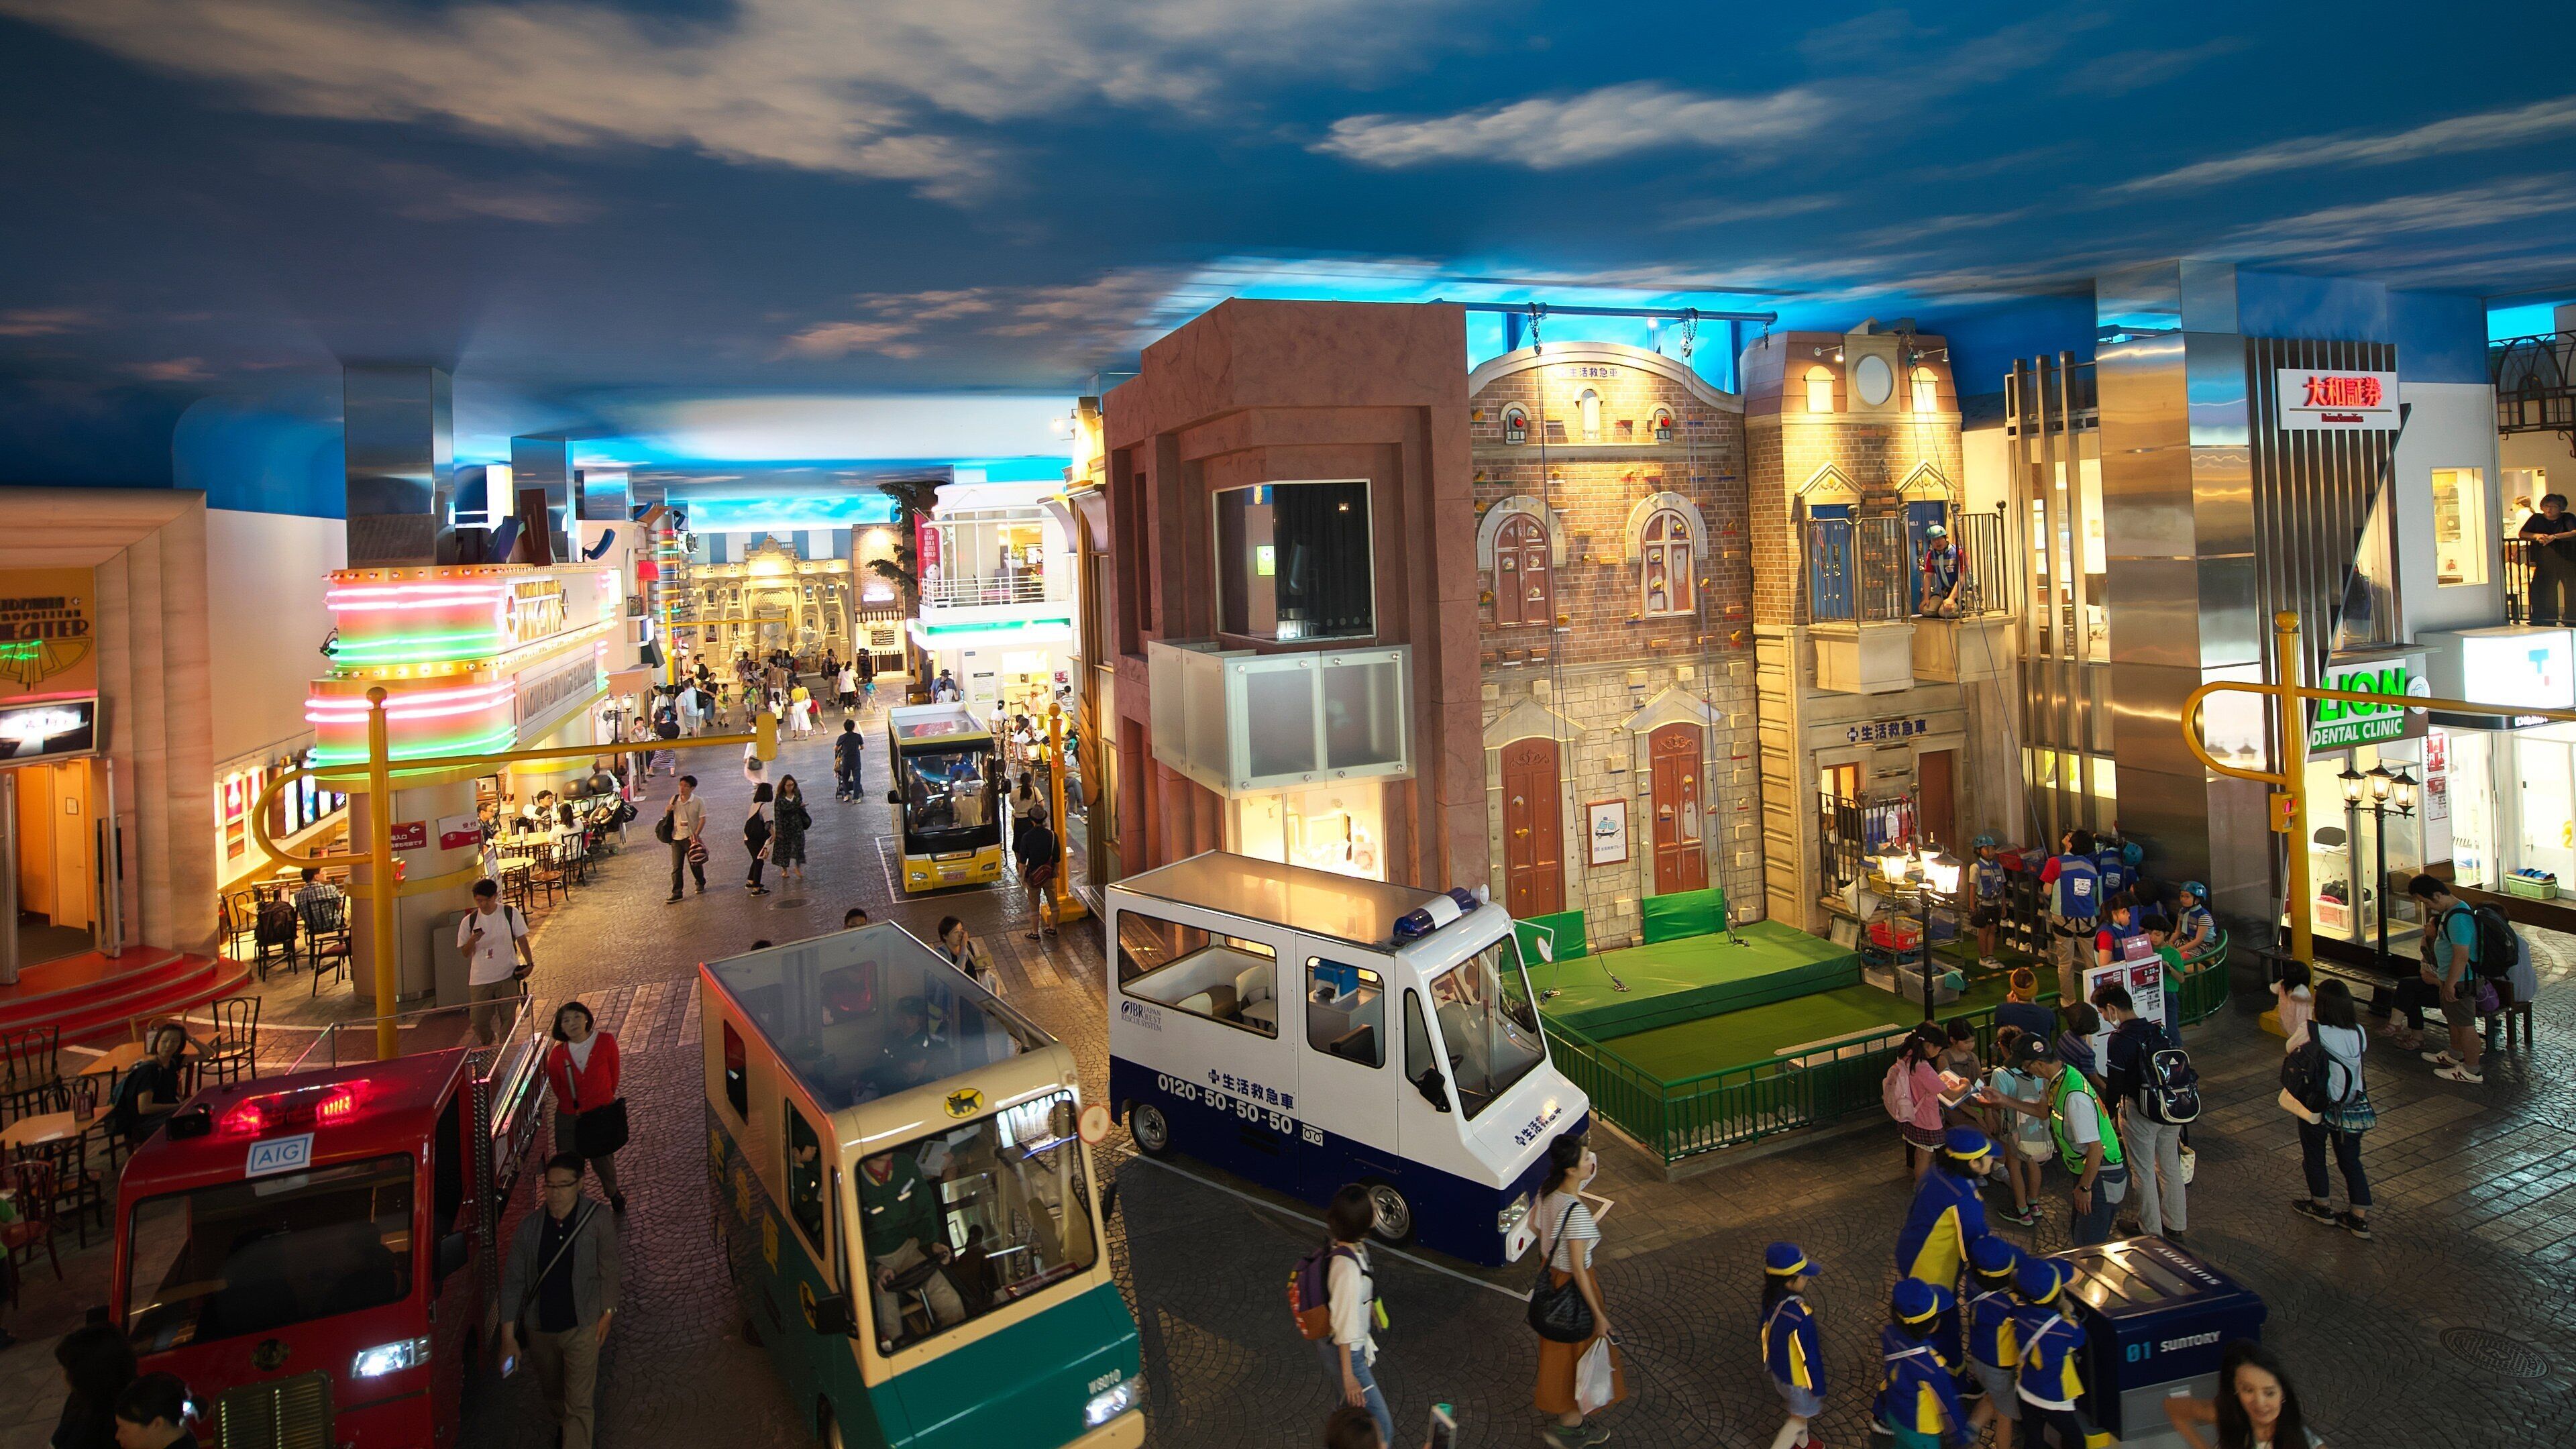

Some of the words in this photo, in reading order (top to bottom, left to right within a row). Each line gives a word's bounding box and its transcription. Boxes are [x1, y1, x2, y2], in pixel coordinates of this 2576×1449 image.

[2303, 375, 2383, 408] 大和証券
[2318, 667, 2406, 722] LION
[1861, 718, 1927, 741] 生活救急車
[2312, 724, 2359, 747] DENTAL
[2362, 717, 2402, 739] CLINIC
[1129, 1001, 1144, 1019] JBR
[1143, 1005, 1161, 1016] JAPAN
[1141, 1019, 1163, 1032] SYSTEM
[1144, 1013, 1161, 1024] BEST
[1158, 1073, 1293, 1134] 0120-50-50-50
[1222, 1073, 1295, 1111] 生活救急車
[258, 1144, 299, 1166] AIG
[2153, 1246, 2223, 1285] SUNTORY
[2126, 1341, 2151, 1363] 01
[2159, 1330, 2222, 1353] SUNTORY
